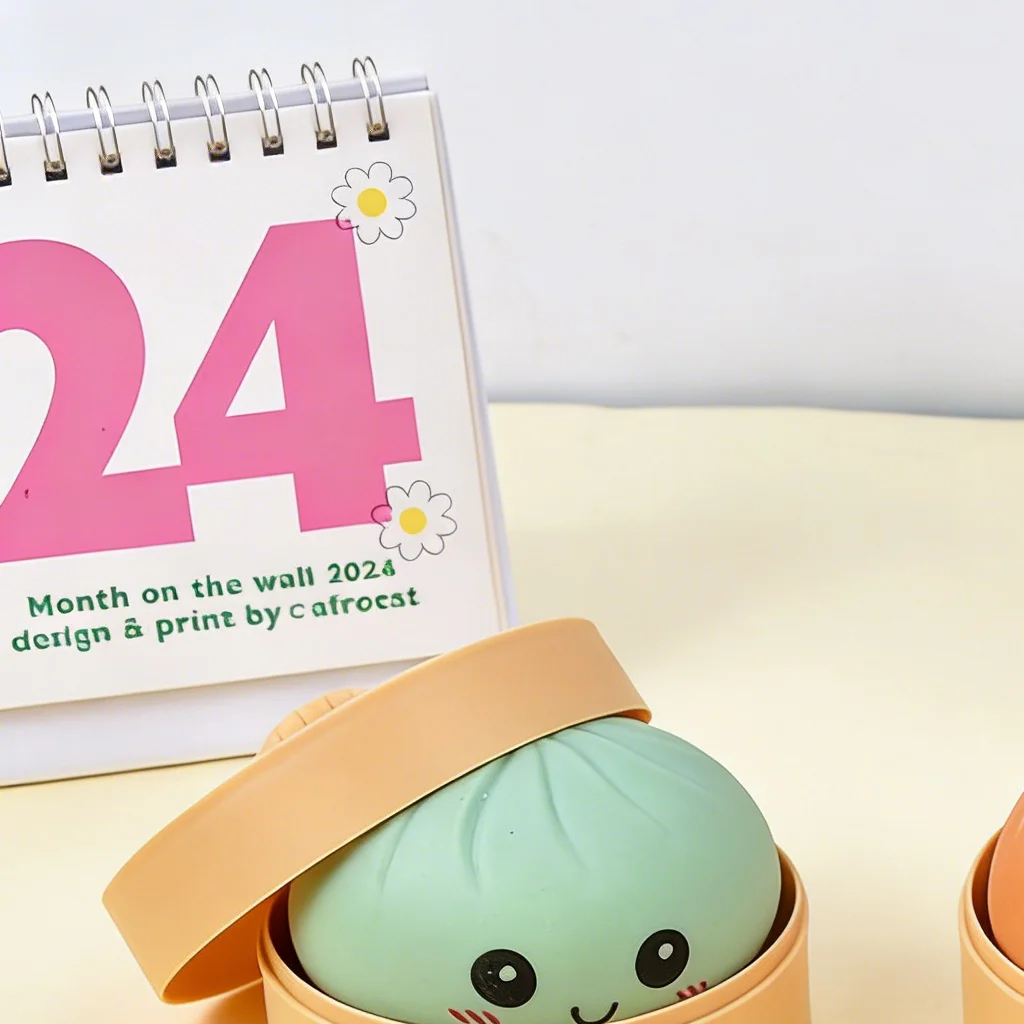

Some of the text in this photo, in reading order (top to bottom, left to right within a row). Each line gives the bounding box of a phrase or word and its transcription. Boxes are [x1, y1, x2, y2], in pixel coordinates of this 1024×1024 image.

[0, 219, 423, 563] 24
[27, 586, 130, 618] Month
[142, 585, 179, 604] on
[191, 572, 243, 598] the
[253, 566, 315, 593] wall
[245, 604, 281, 631] by
